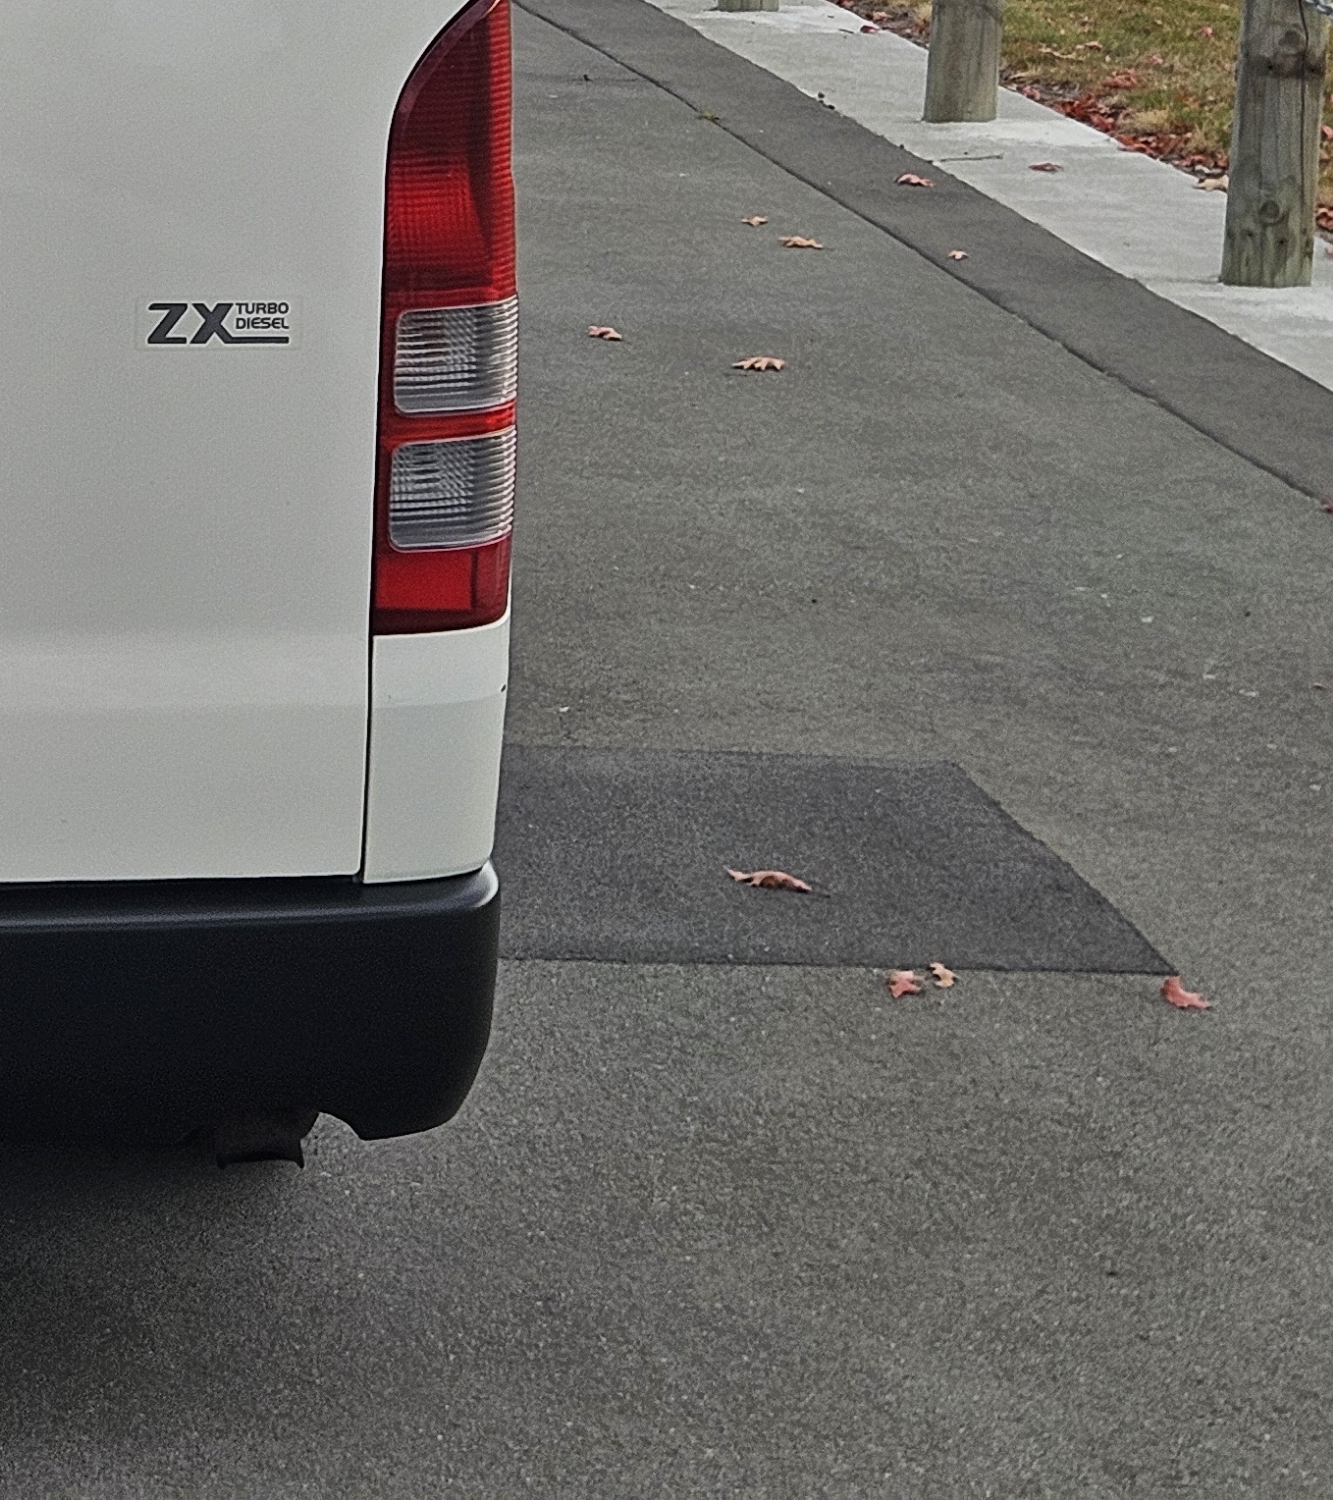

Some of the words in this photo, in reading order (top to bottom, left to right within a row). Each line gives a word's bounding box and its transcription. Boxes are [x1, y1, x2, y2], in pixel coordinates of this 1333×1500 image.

[147, 303, 234, 344] ZX
[235, 303, 289, 314] TURBO
[235, 317, 289, 329] DIESEL
